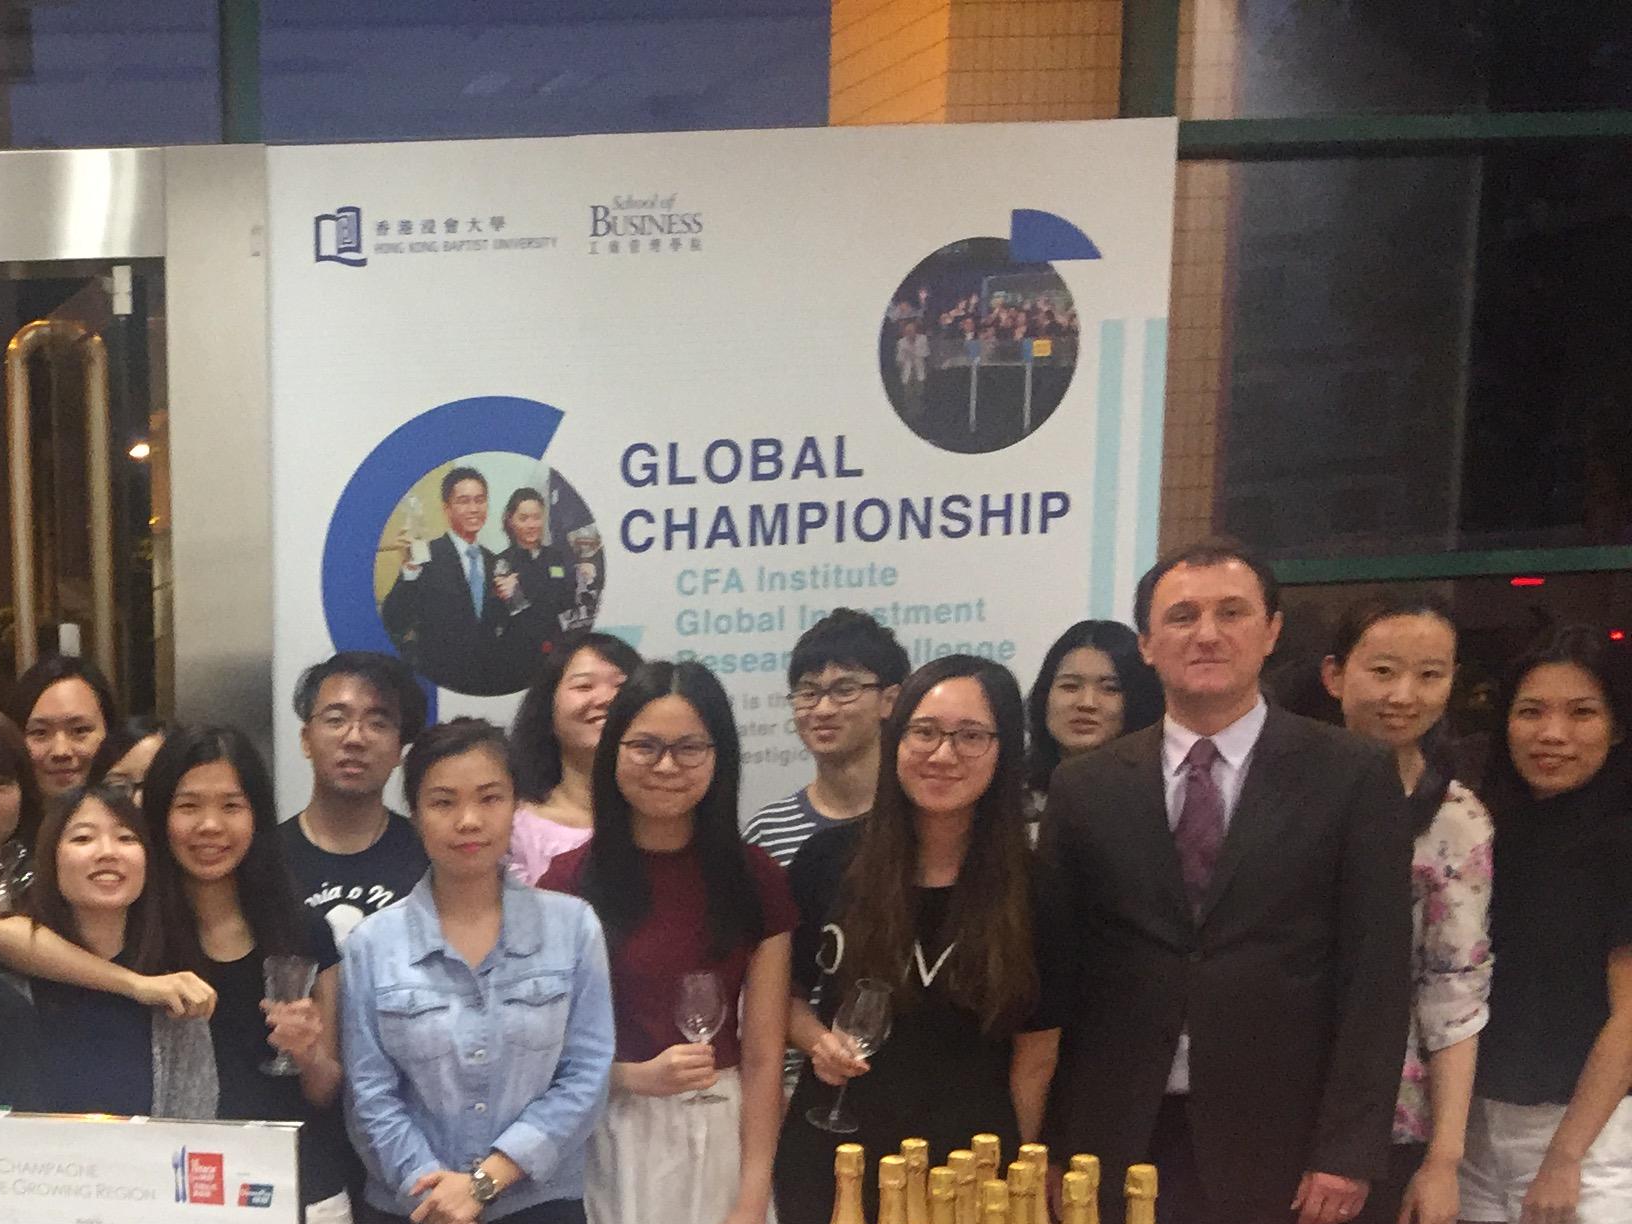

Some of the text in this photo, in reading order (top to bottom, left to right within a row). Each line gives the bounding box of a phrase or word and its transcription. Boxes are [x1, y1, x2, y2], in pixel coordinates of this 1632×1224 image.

[590, 205, 703, 237] BUSINESS
[408, 241, 439, 253] KONG
[492, 237, 558, 250] UNIVERSITY
[620, 435, 864, 488] GLOBAL
[620, 490, 1071, 553] CHAMPIONSHIP
[676, 562, 897, 596] CFA Institute
[676, 598, 985, 636] Global Instment
